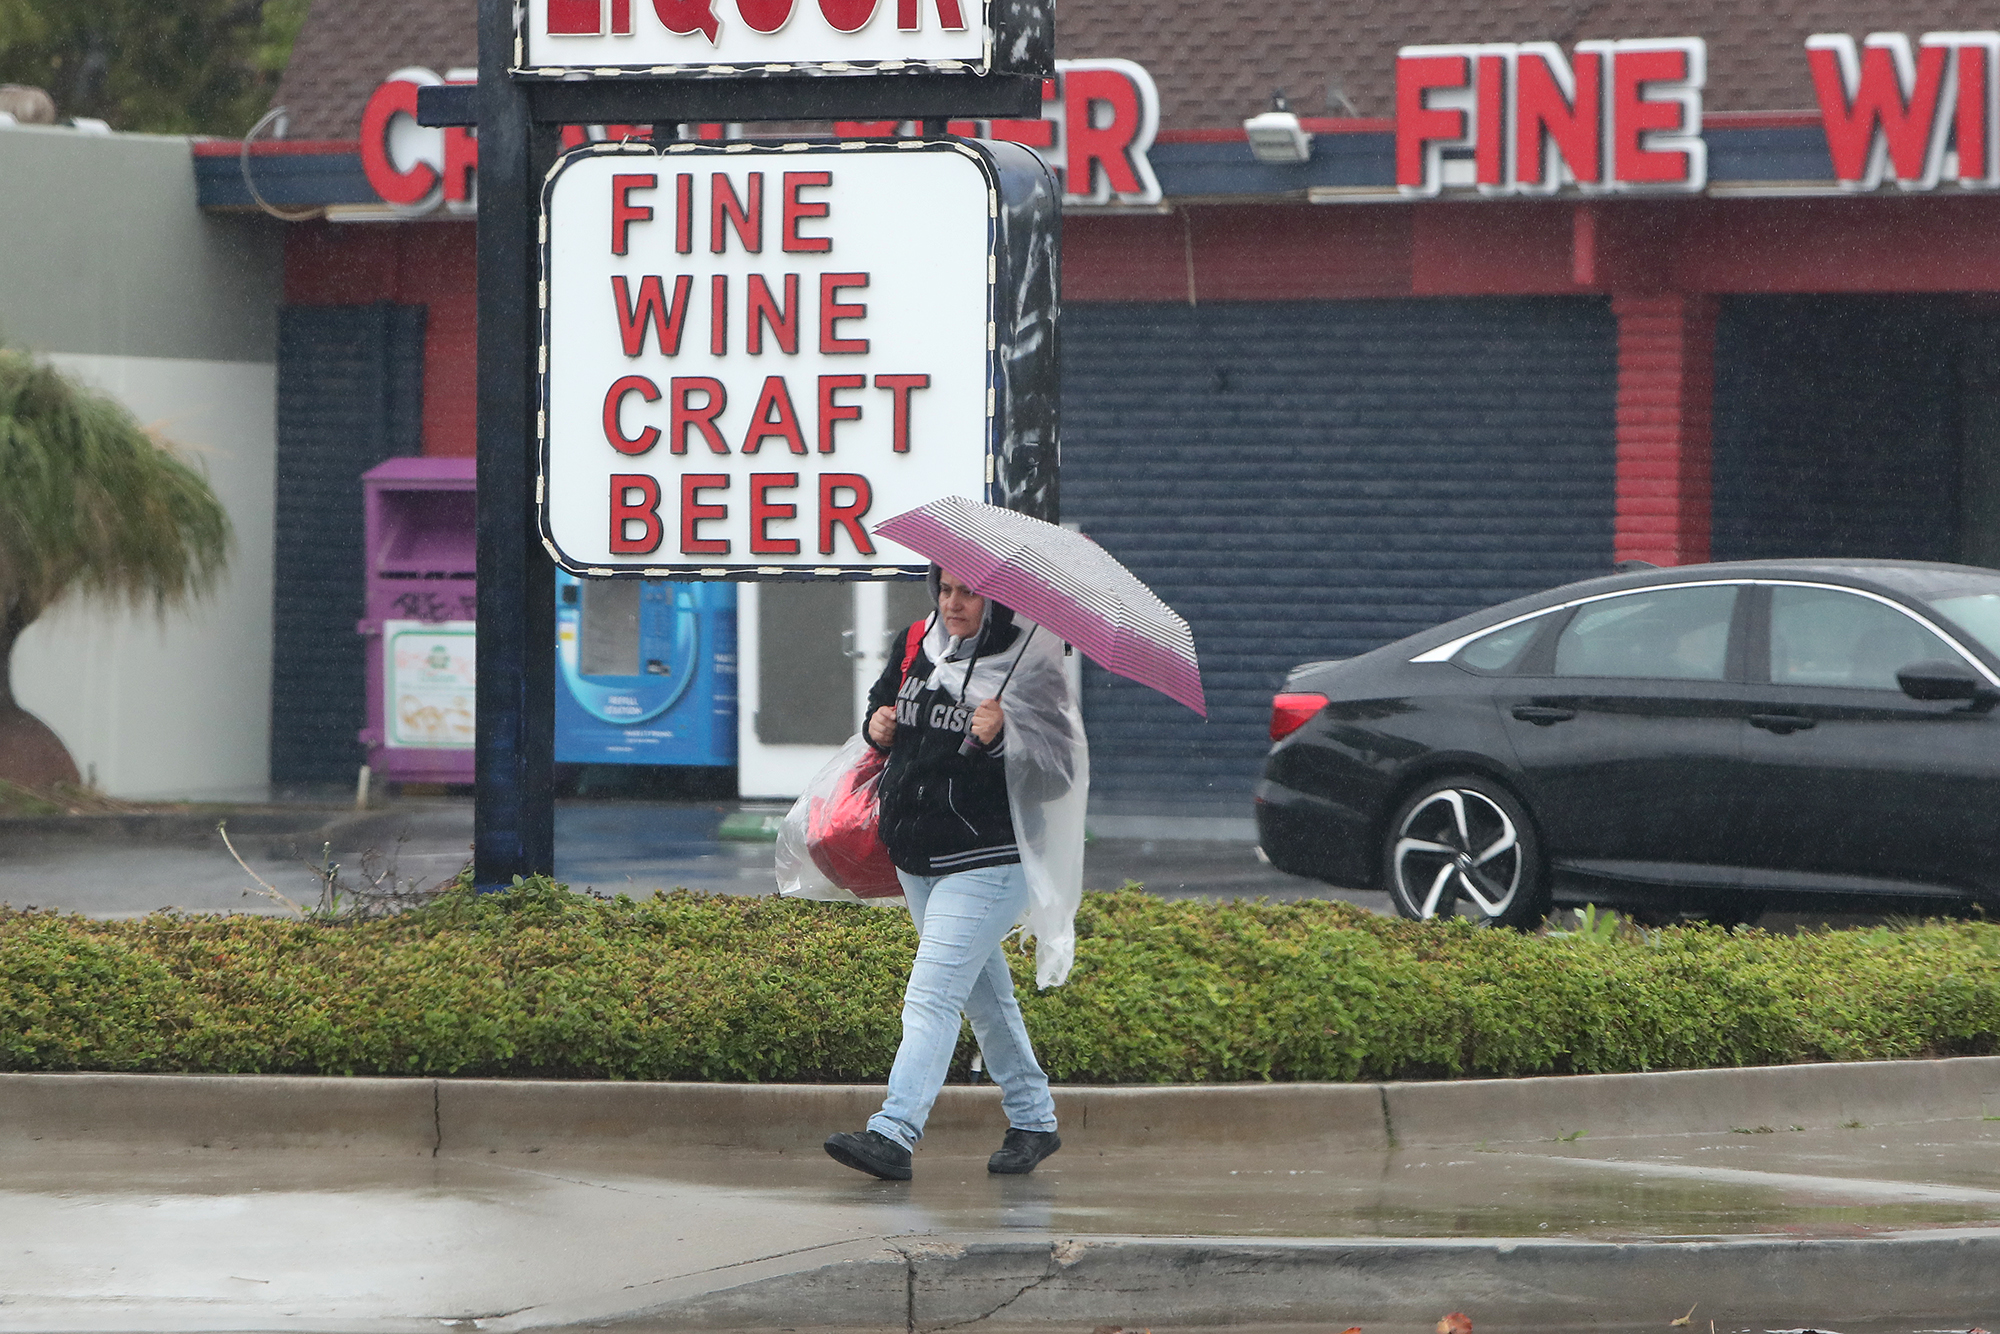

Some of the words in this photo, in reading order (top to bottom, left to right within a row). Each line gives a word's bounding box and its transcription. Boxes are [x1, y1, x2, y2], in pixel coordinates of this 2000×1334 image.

[1397, 40, 1705, 195] FINE
[611, 171, 833, 255] FINE
[611, 271, 870, 356] WINE
[602, 373, 930, 455] CRAFT
[609, 472, 876, 556] BEER
